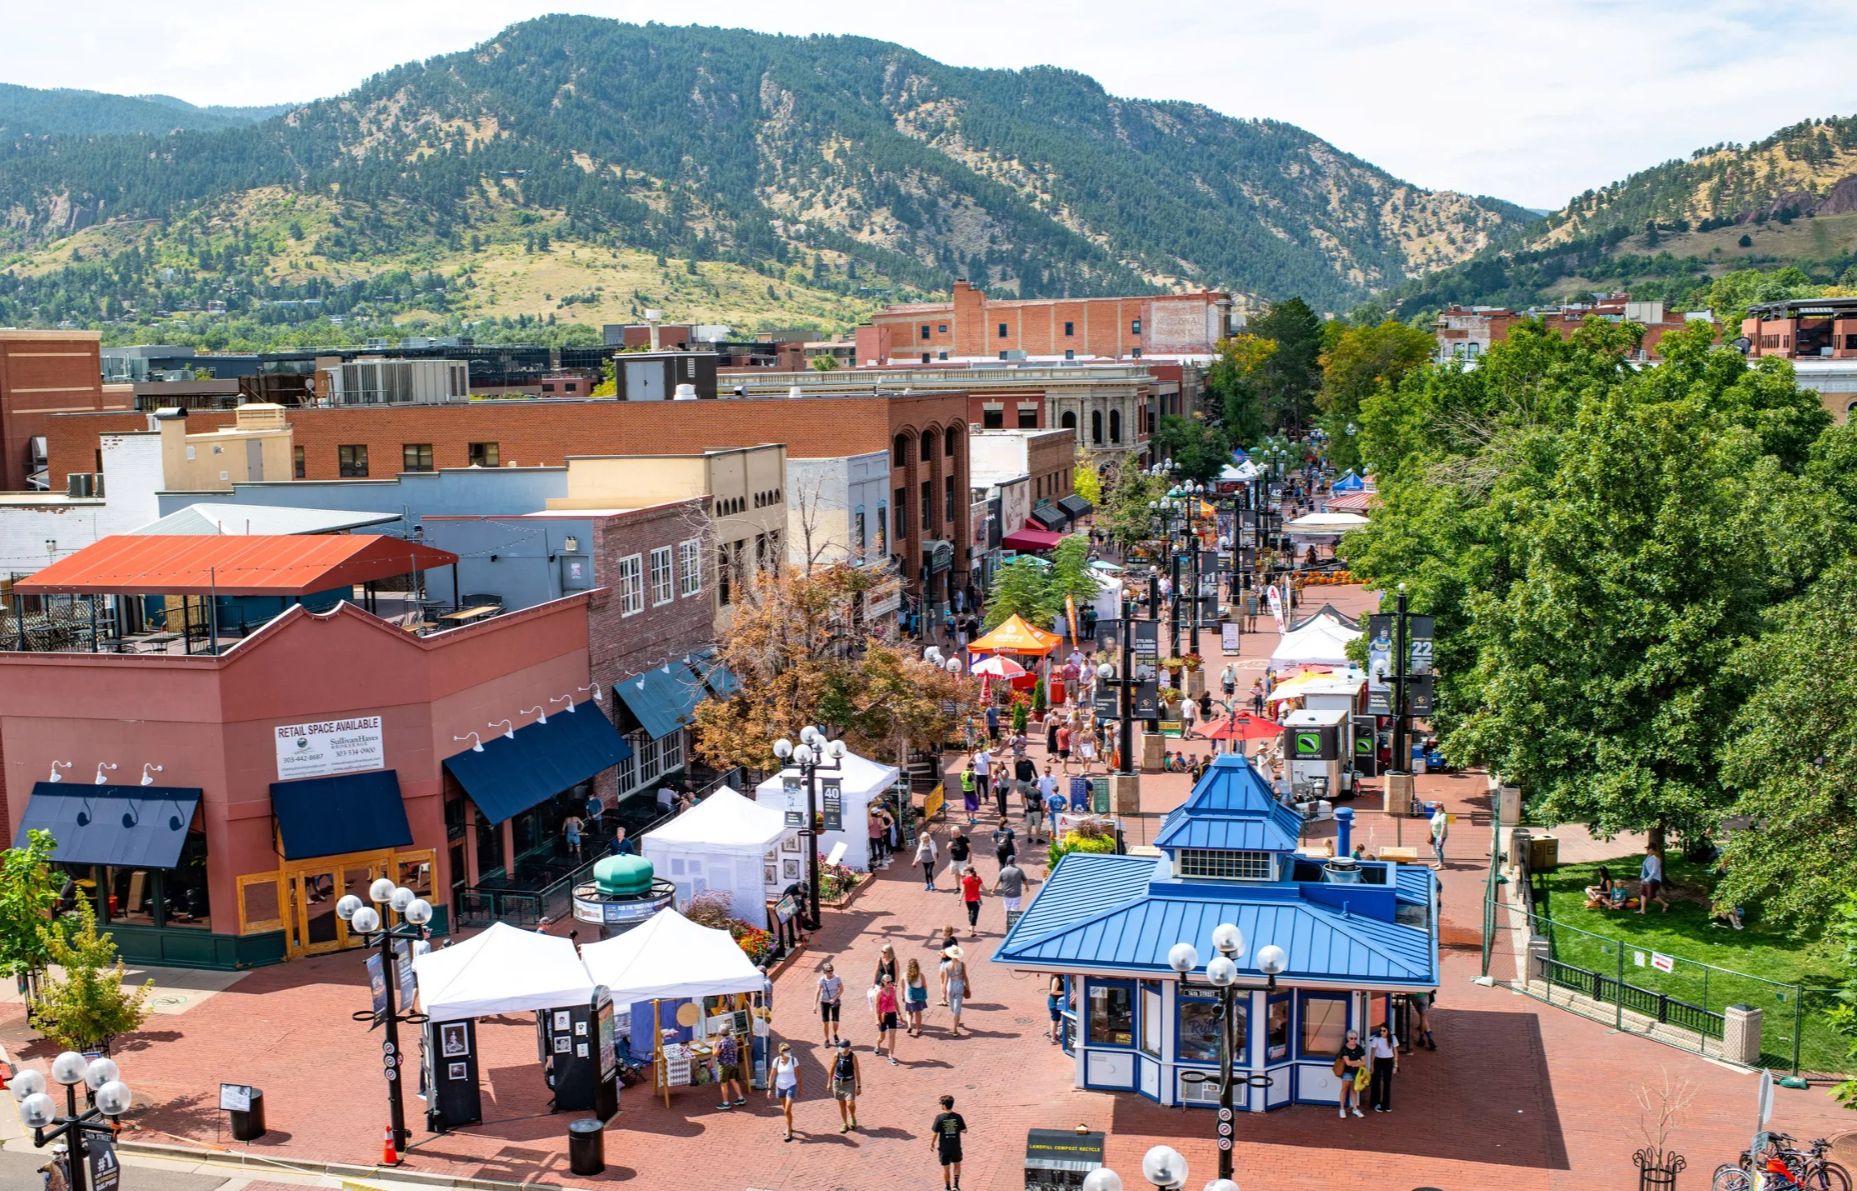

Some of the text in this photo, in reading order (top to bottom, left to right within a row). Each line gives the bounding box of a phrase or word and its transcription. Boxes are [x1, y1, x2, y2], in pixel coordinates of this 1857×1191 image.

[1271, 489, 1281, 497] 42
[1411, 641, 1433, 656] 22
[278, 718, 379, 738] RETAIL SPACE AVAILABLE
[824, 788, 840, 799] 40
[97, 1150, 113, 1171] #1
